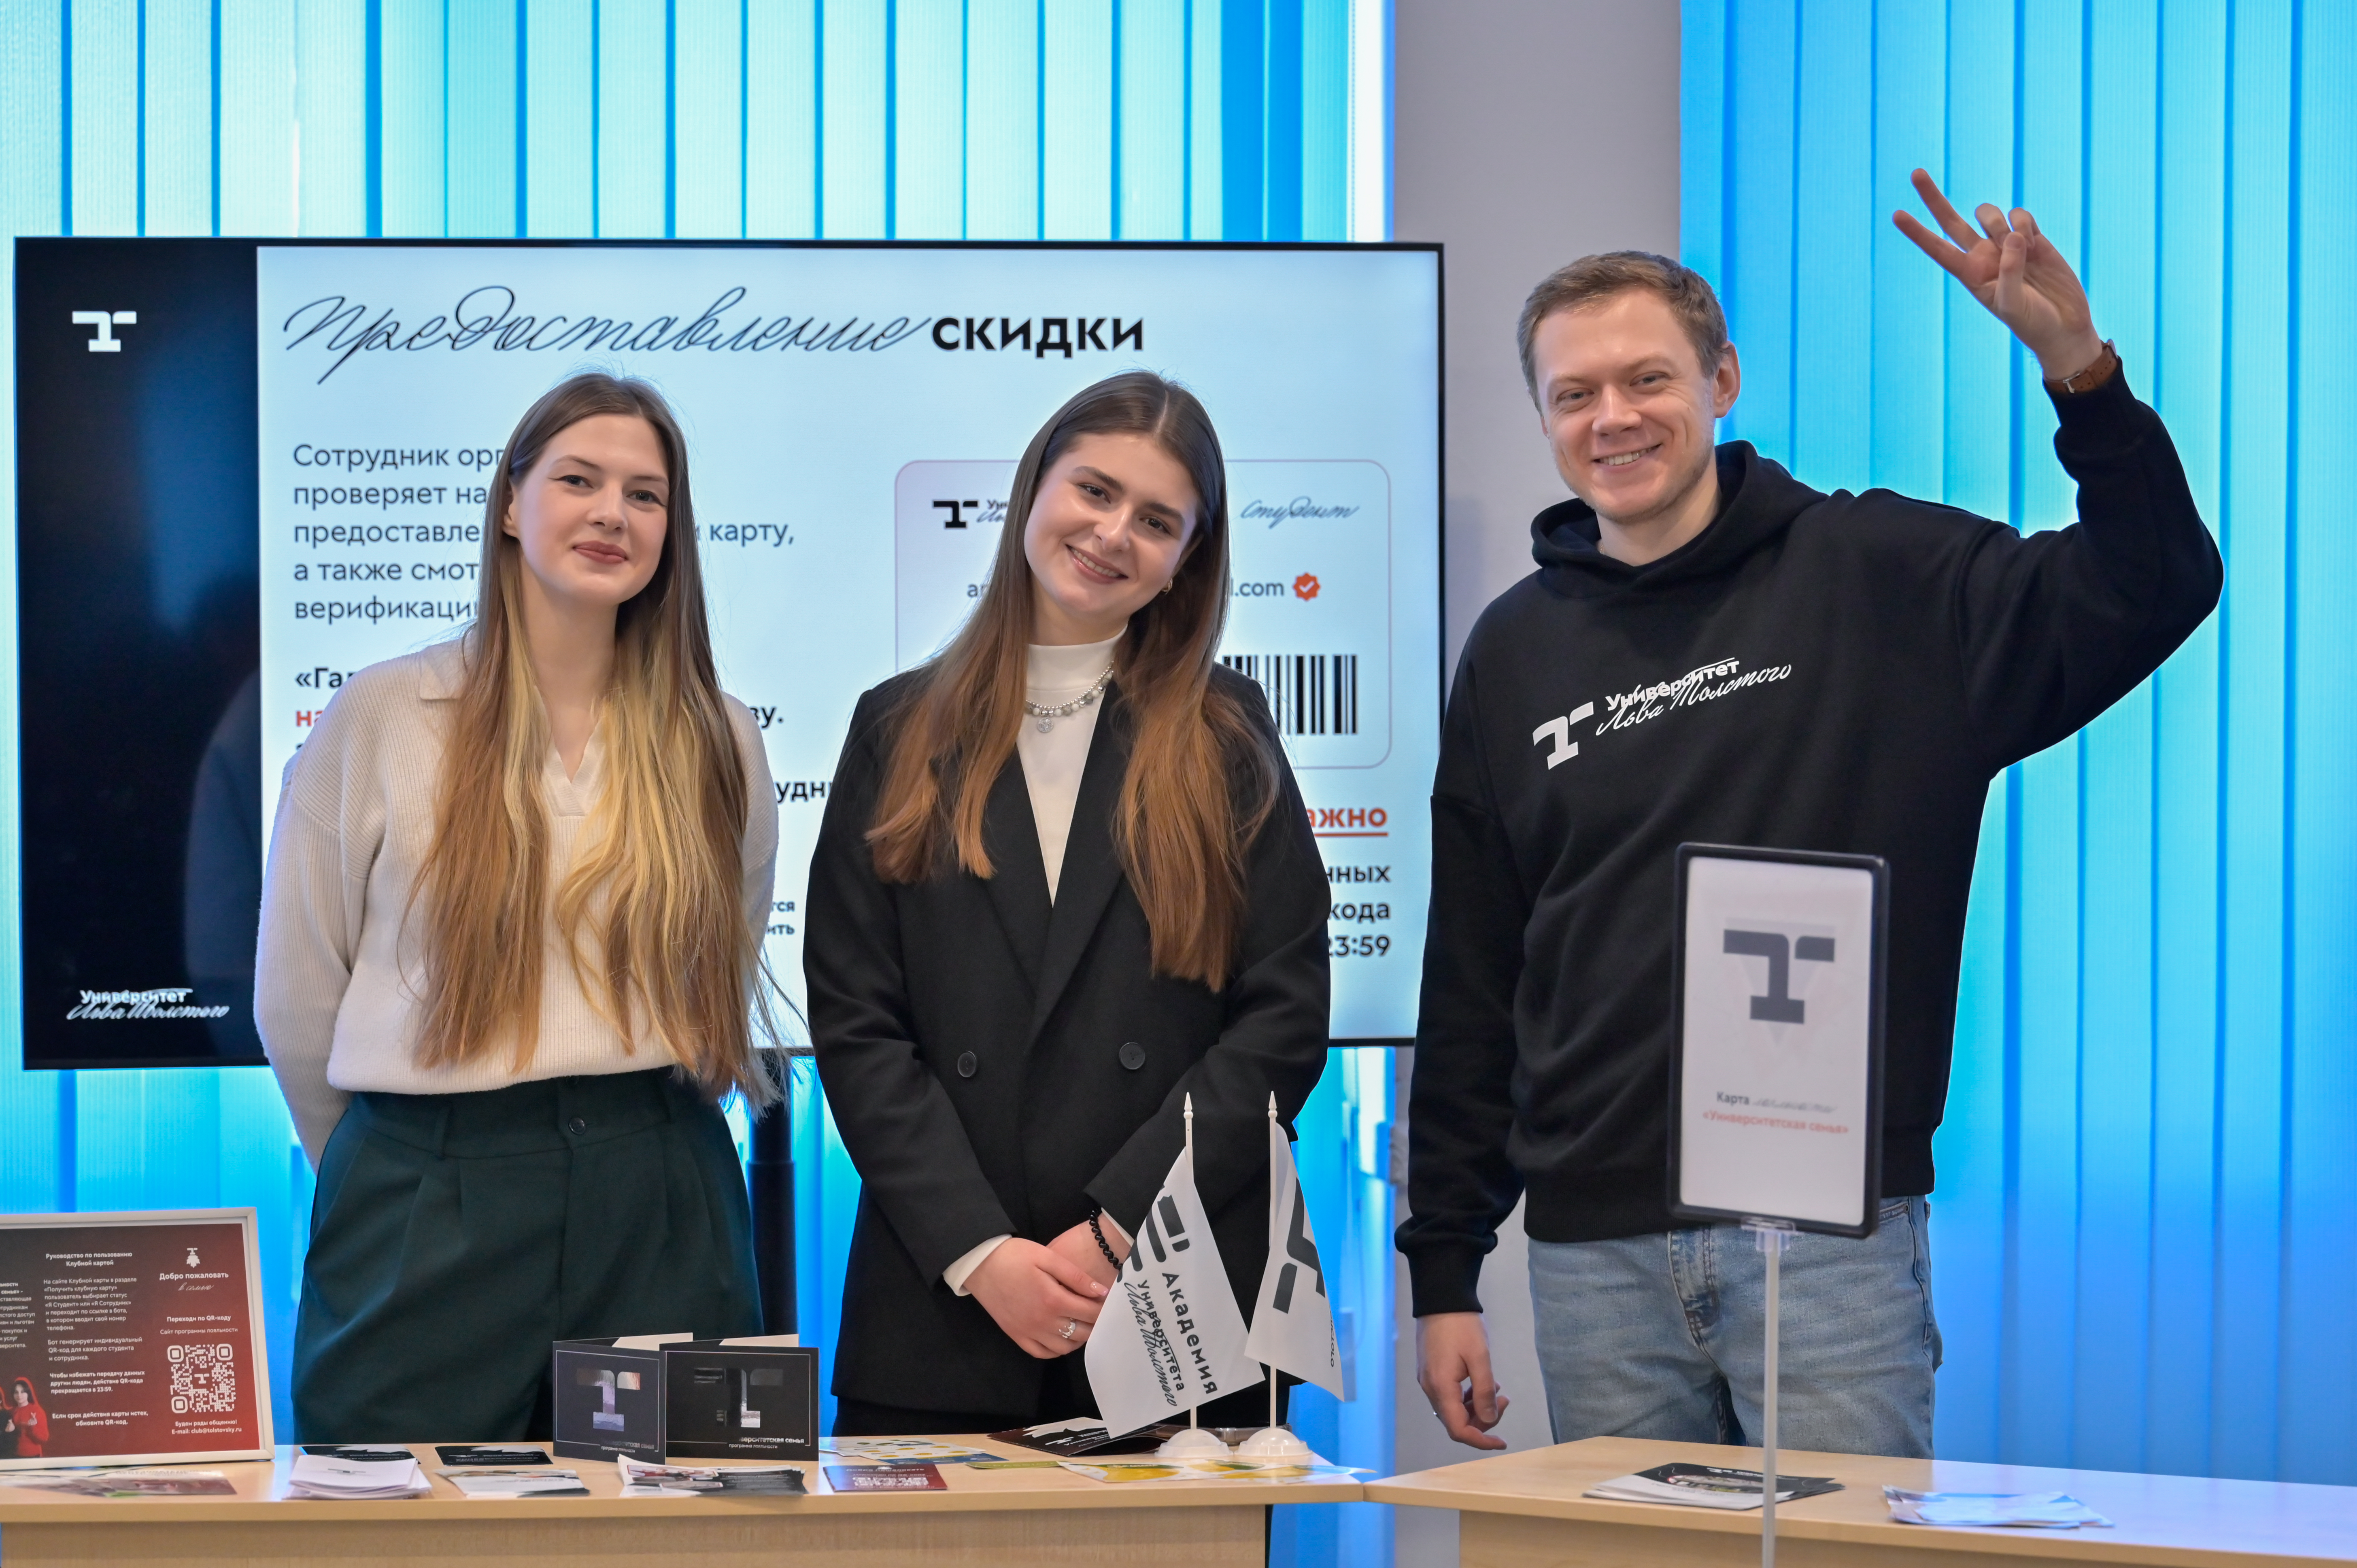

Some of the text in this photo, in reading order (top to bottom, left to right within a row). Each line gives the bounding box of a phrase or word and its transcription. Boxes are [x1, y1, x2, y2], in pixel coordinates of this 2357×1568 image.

[931, 317, 1144, 359] скидки
[293, 444, 450, 473] Сотрудник
[294, 487, 447, 510] проверяет
[710, 524, 794, 547] карту,
[294, 563, 308, 580] а
[318, 563, 402, 580] также
[295, 595, 474, 625] верификаци
[1595, 661, 1792, 736] Льва Толстого
[1605, 660, 1740, 711] Университет
[1306, 807, 1388, 827] ажно
[80, 990, 187, 1005] Университет
[1717, 1092, 1749, 1106] Карта
[1162, 1273, 1218, 1394] Академия
